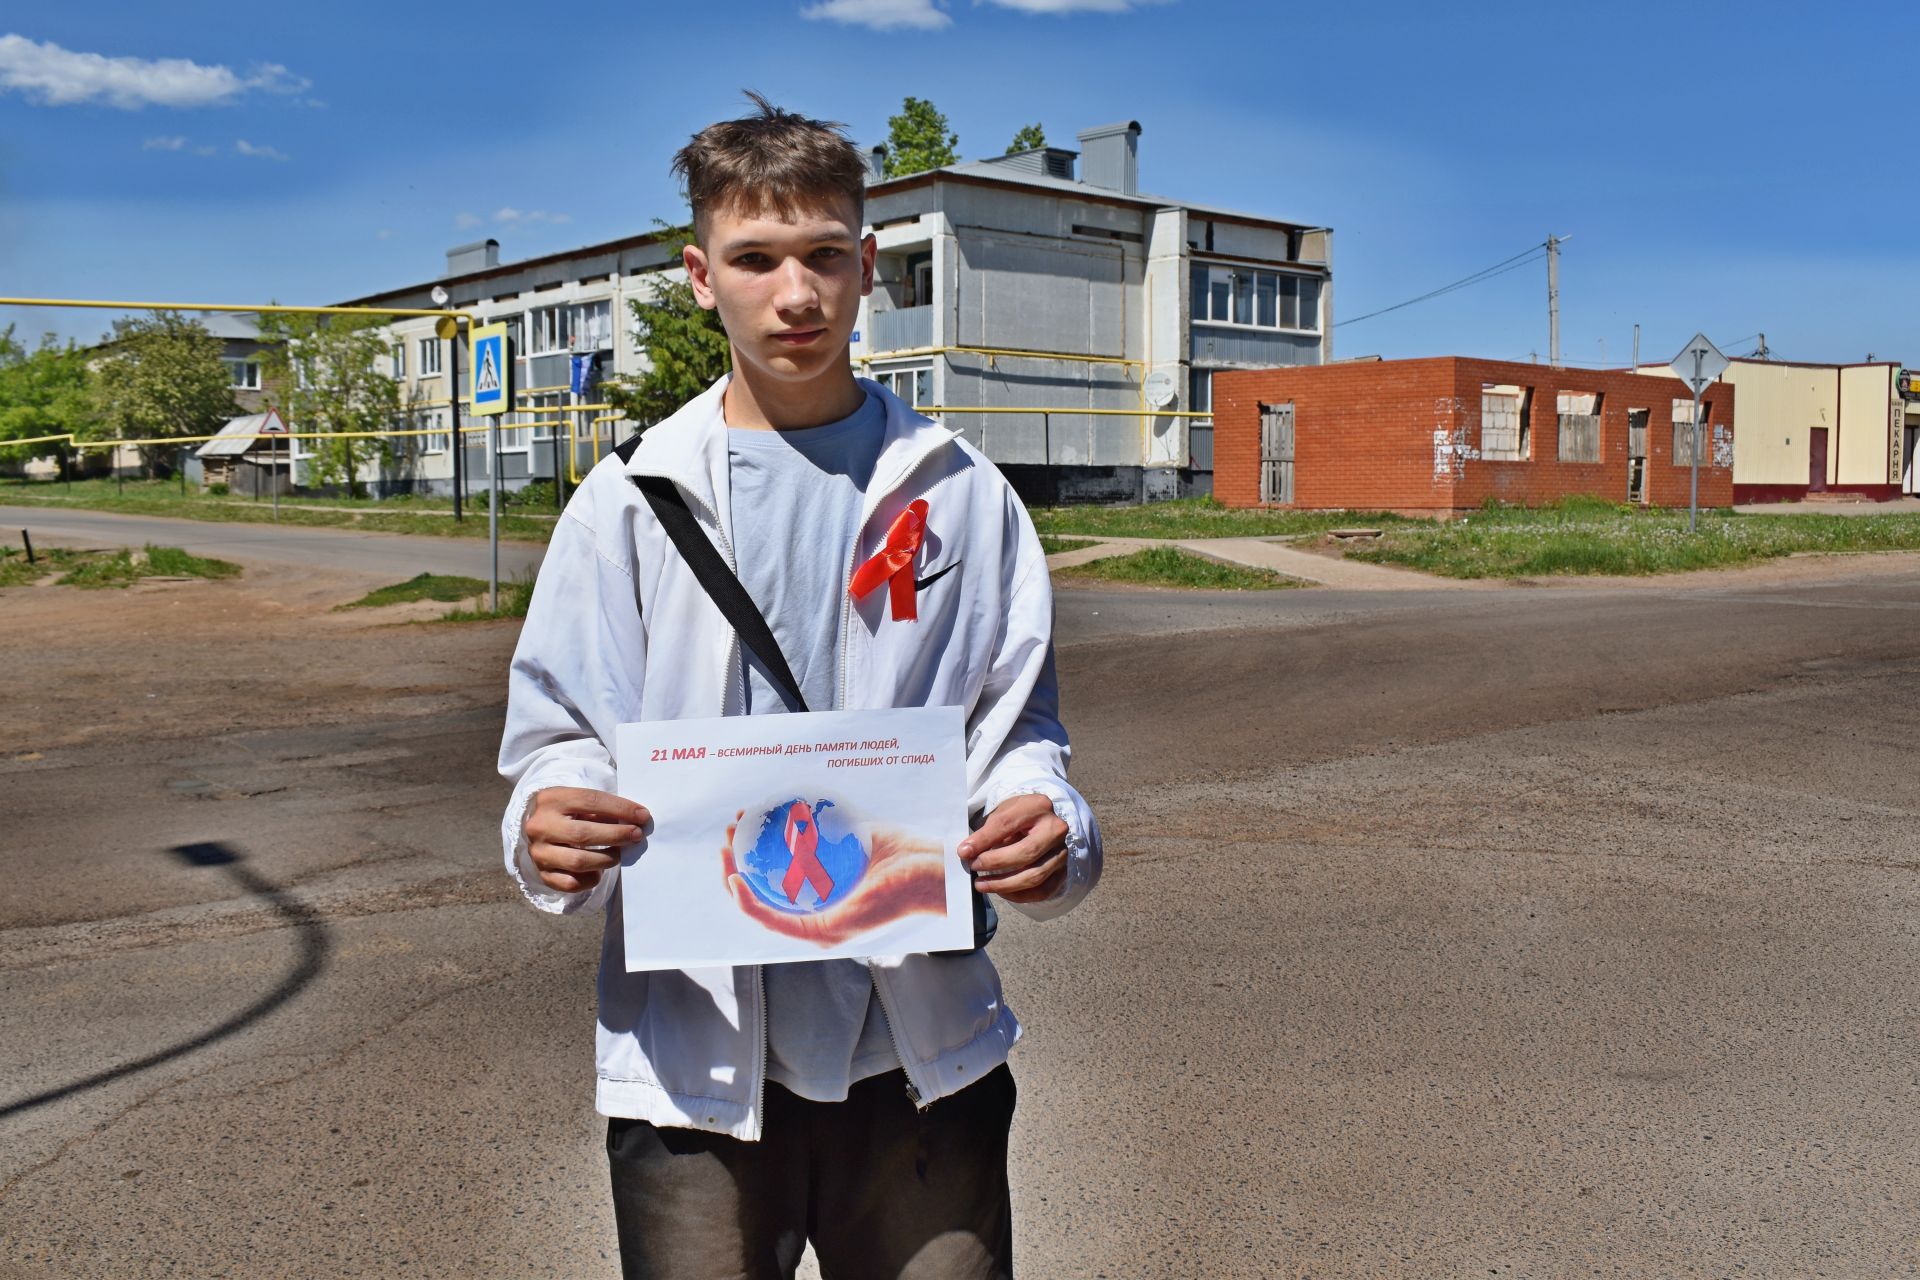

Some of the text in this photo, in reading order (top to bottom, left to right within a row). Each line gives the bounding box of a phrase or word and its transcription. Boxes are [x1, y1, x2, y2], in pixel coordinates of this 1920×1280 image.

[1892, 408, 1901, 479] ПЕКАРНЯ
[651, 749, 668, 762] 21
[672, 746, 707, 761] МАЯ
[717, 743, 783, 758] ВСЕМИРНЫЙ
[784, 743, 812, 756] ДЕНЬ
[814, 741, 858, 753] ПАМЯТИ
[859, 737, 900, 751] ЛЮДЕЙ,
[827, 753, 935, 768] ПОГИБШИХ ОТ СПИДА
